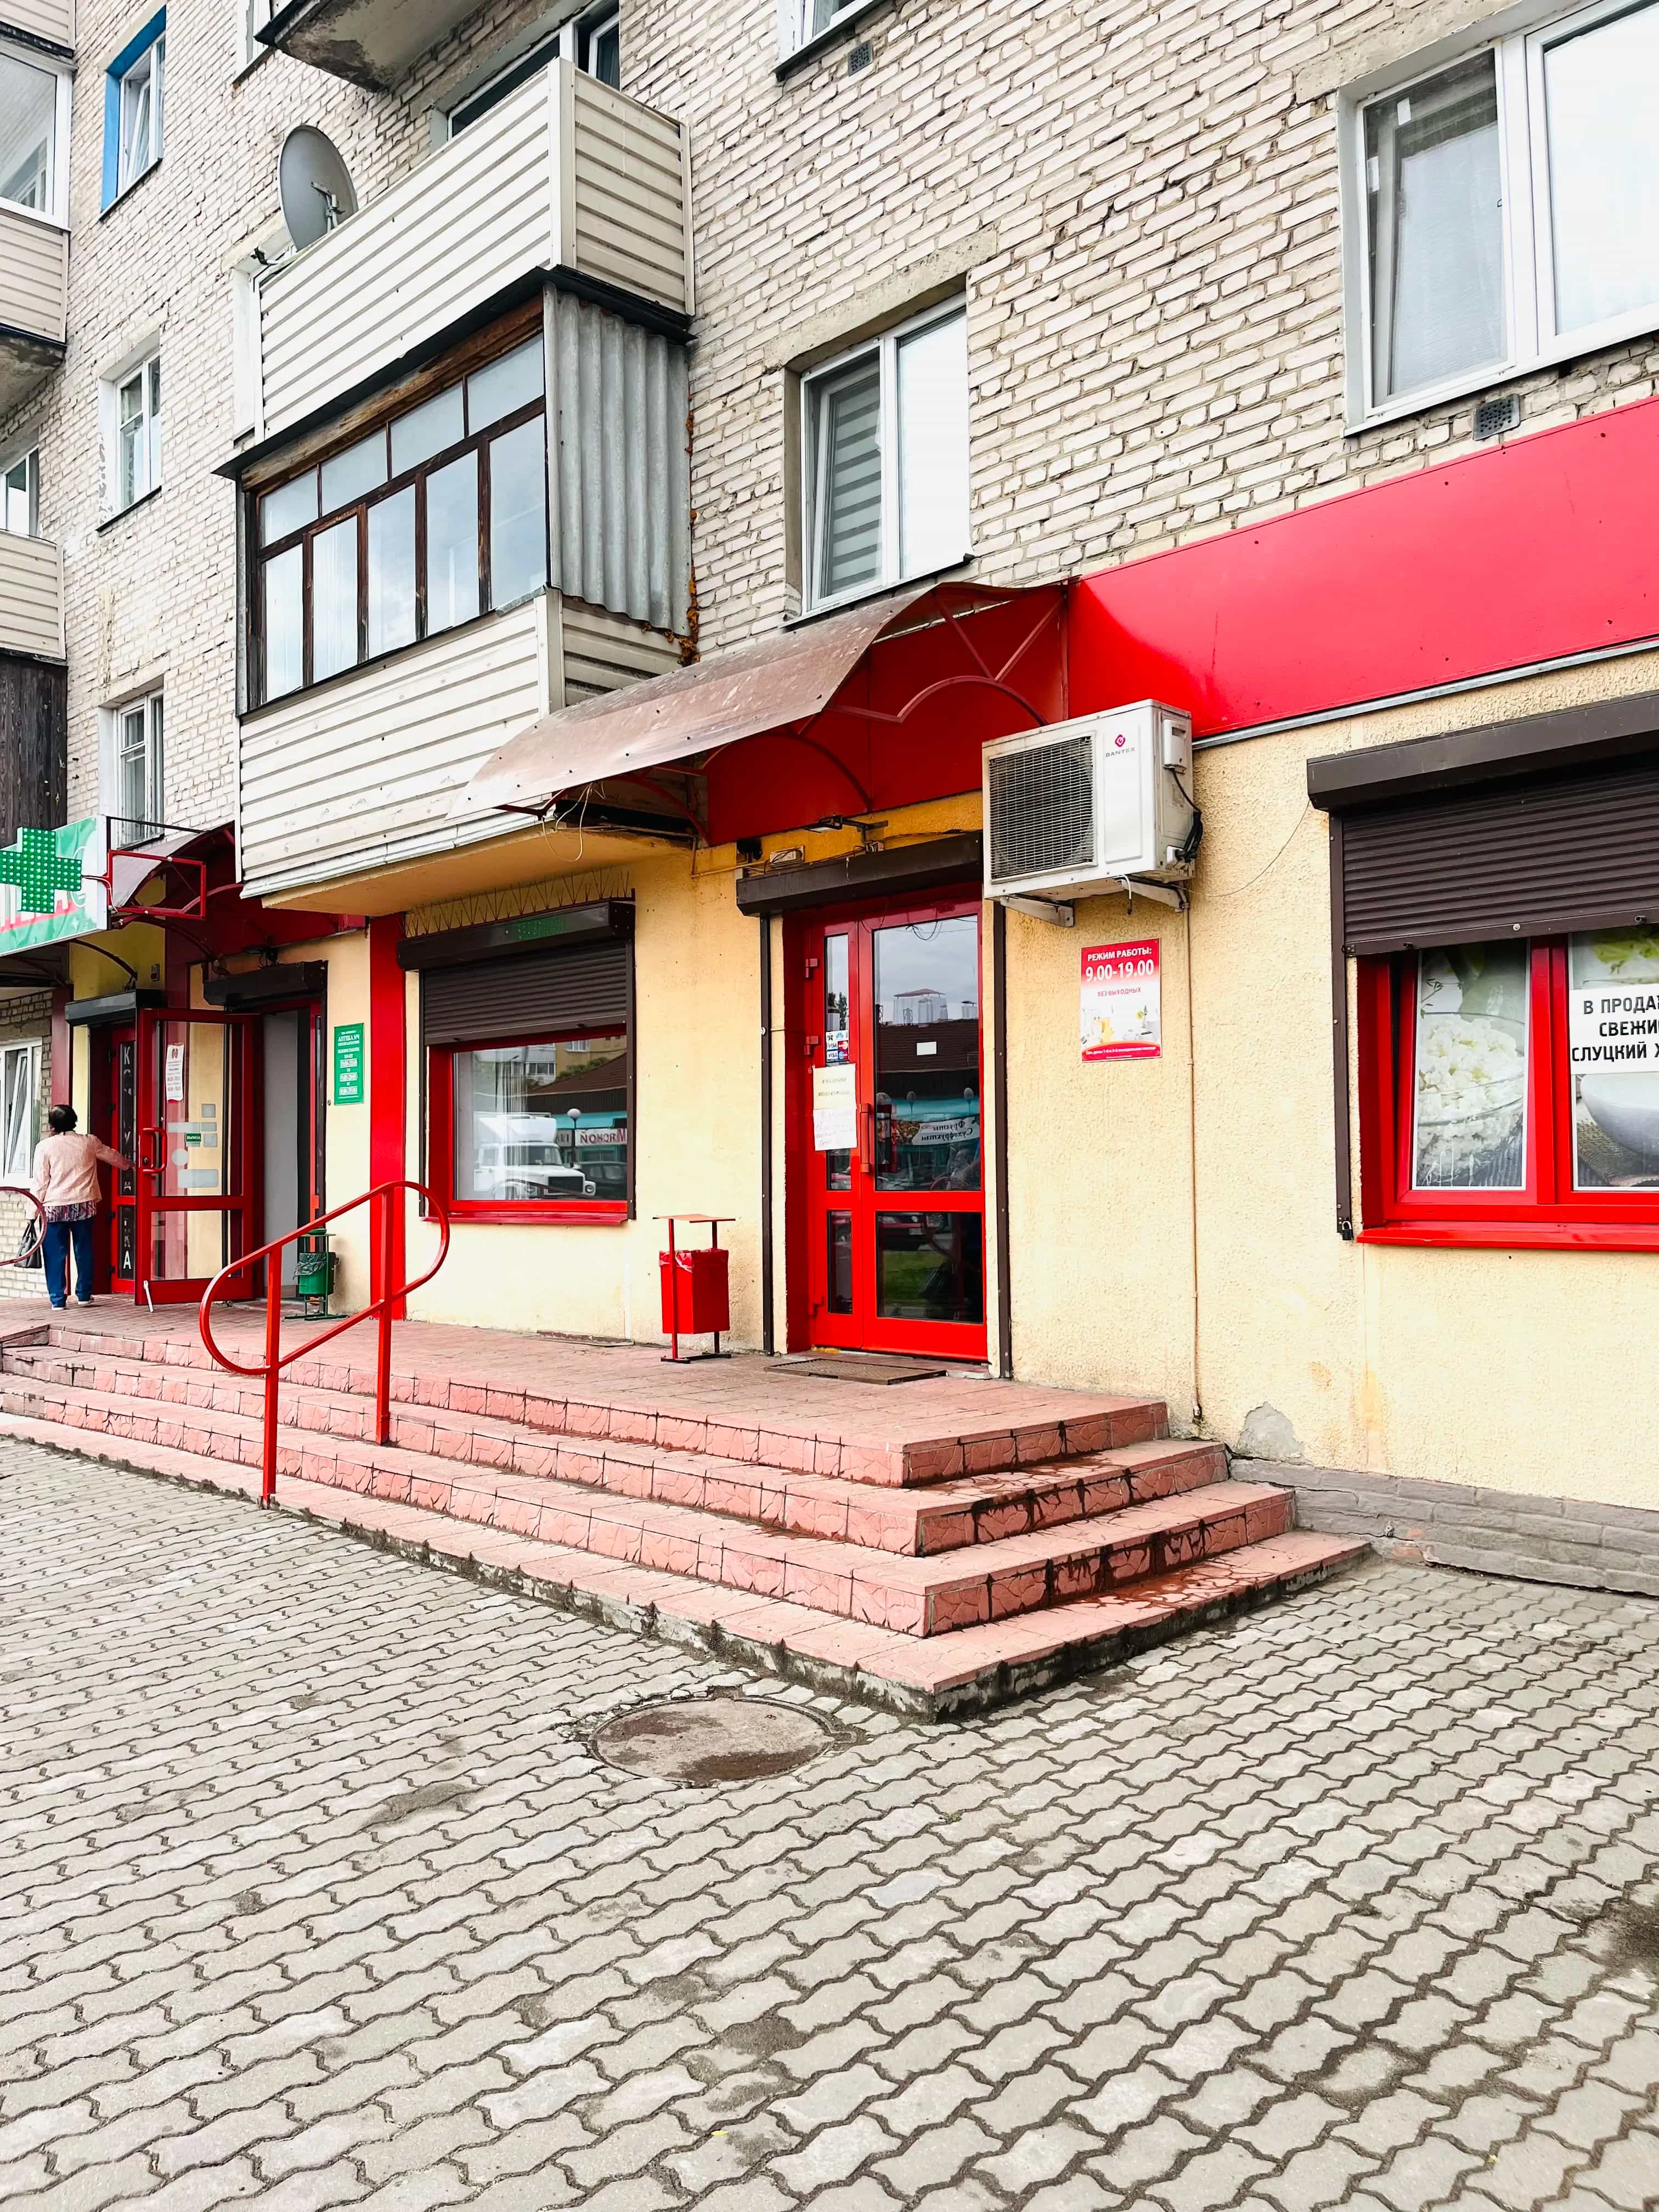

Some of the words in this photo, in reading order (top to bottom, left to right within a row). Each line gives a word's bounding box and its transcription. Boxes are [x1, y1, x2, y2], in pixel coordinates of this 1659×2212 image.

[1087, 951, 1115, 961] РЕЖИМ
[1116, 947, 1152, 958] РАБОТЫ:
[1085, 959, 1154, 983] 9.00-19.00
[1108, 988, 1141, 996] ВЫХОДНЫХ
[1583, 1000, 1594, 1014] В
[1601, 995, 1659, 1014] ПРОДА
[1599, 1019, 1659, 1037] СВЕЖИ
[1572, 1041, 1647, 1062] СЛУЦКИЙ
